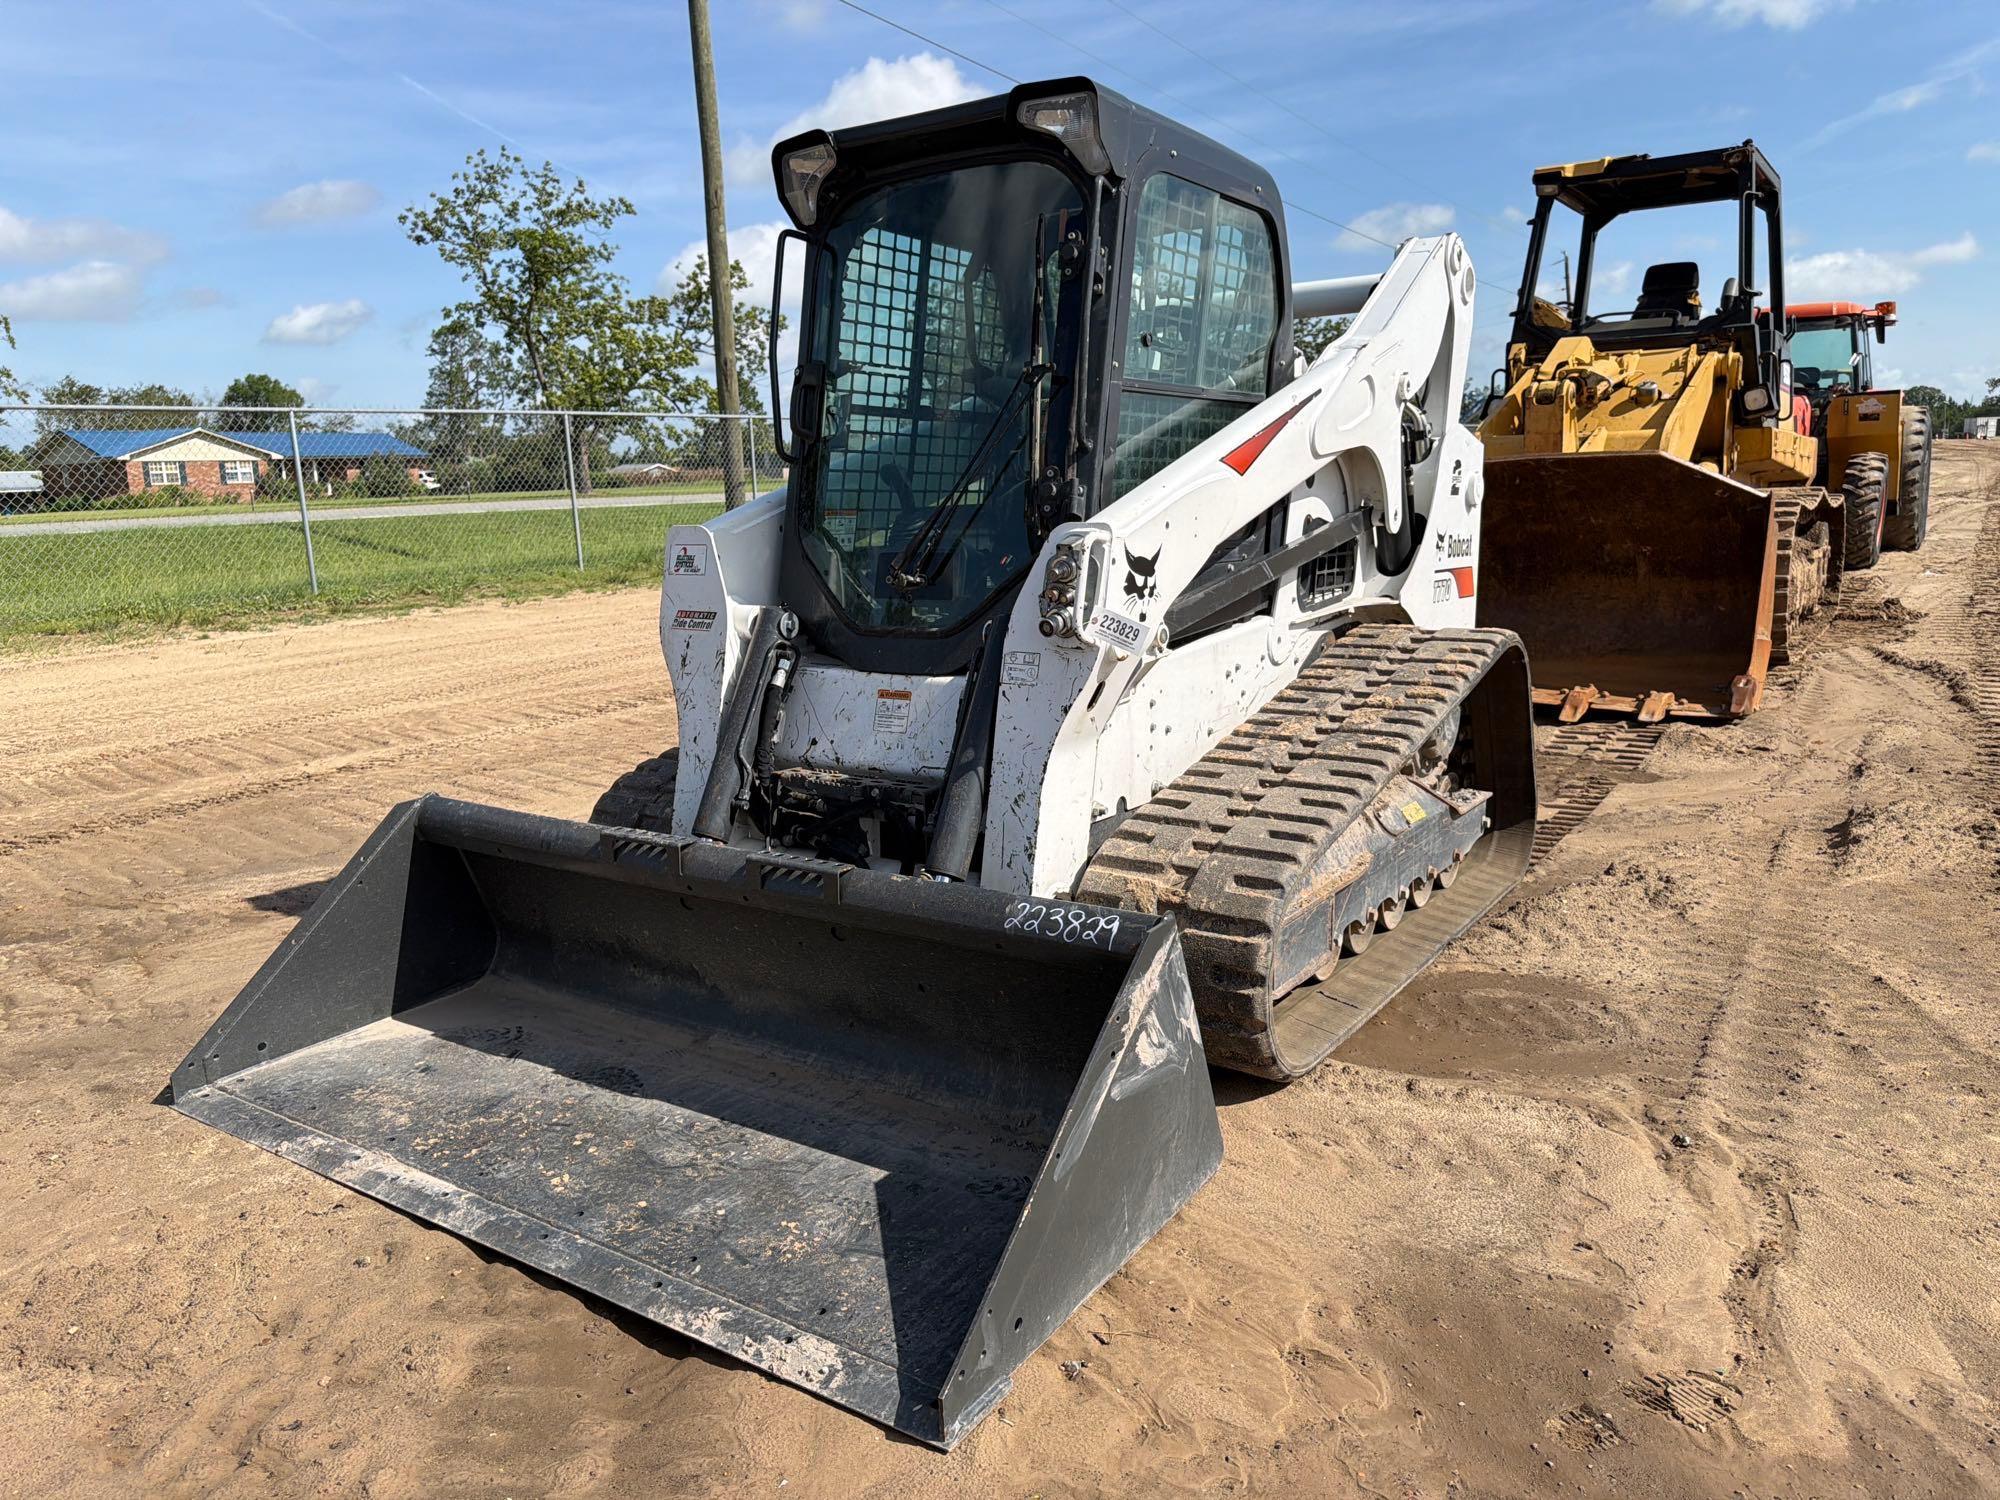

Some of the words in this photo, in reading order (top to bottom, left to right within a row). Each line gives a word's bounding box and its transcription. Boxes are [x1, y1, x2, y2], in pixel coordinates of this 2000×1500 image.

[1448, 534, 1472, 558] Bobcat
[677, 611, 716, 619] AUTOMATIC
[687, 620, 713, 629] Control
[1099, 613, 1140, 642] 223829
[1004, 902, 1120, 951] 223829
